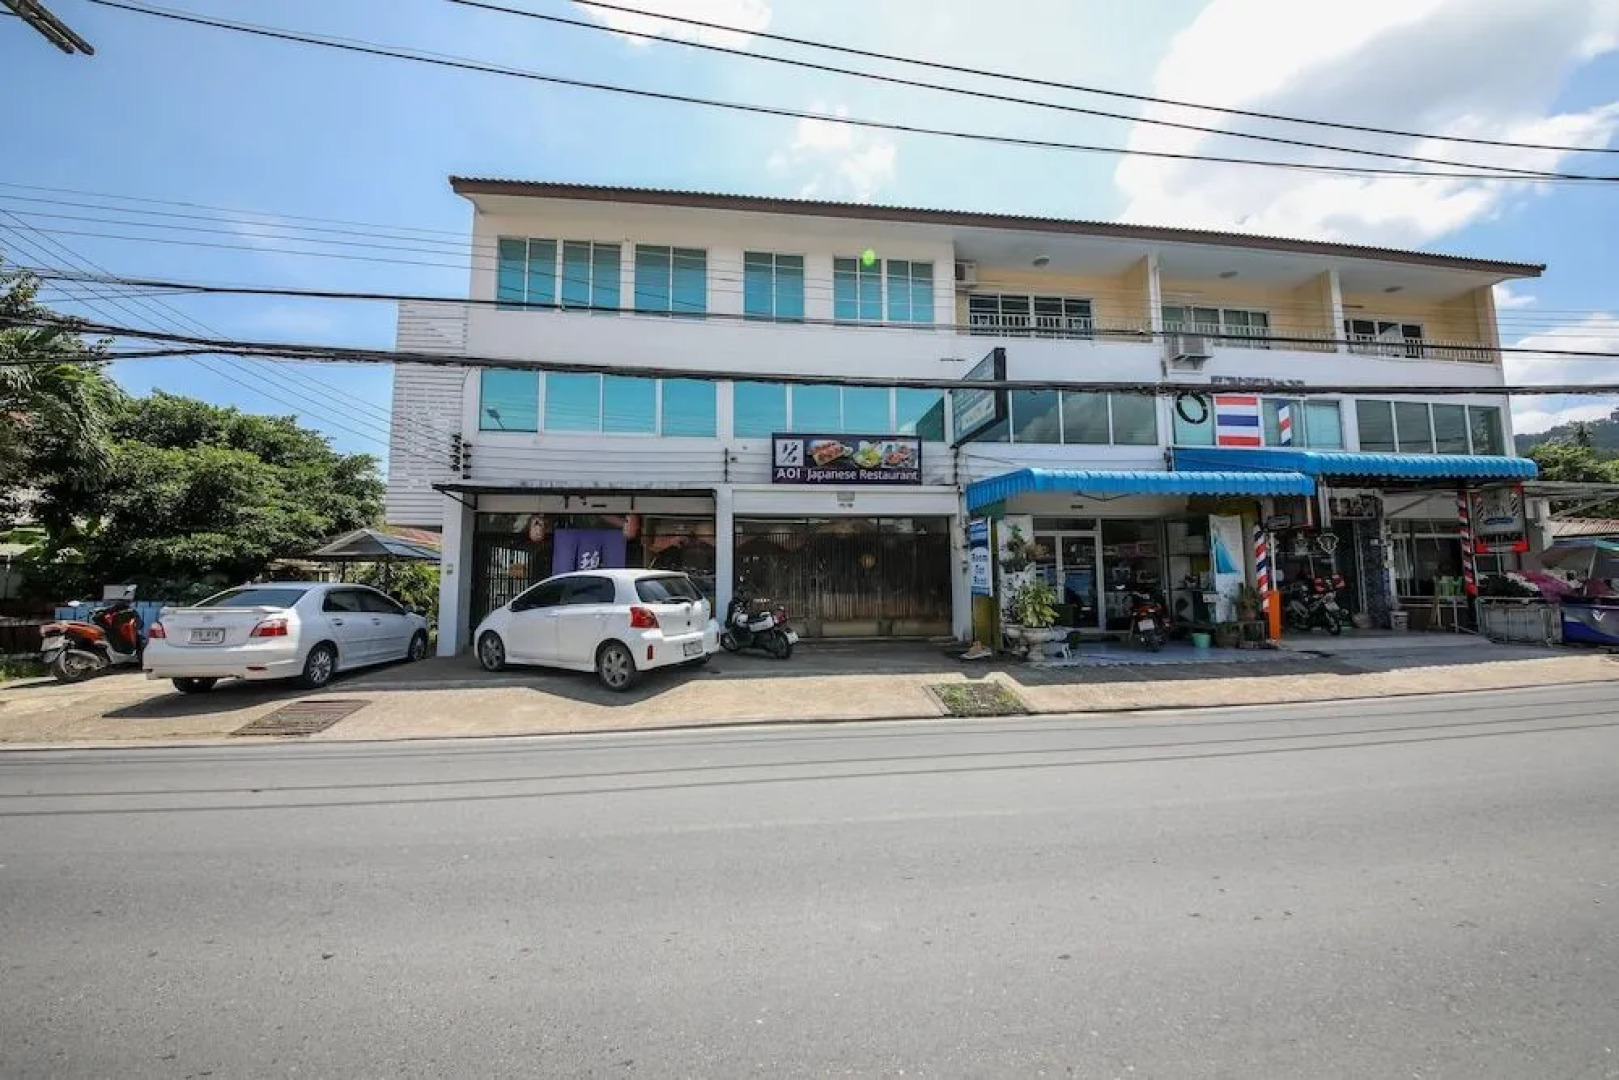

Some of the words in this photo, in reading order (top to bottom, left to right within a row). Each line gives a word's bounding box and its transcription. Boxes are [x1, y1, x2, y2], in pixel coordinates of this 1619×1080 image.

[776, 467, 801, 479] AOI
[807, 469, 857, 481] Japanese
[859, 469, 918, 480] Restaurant
